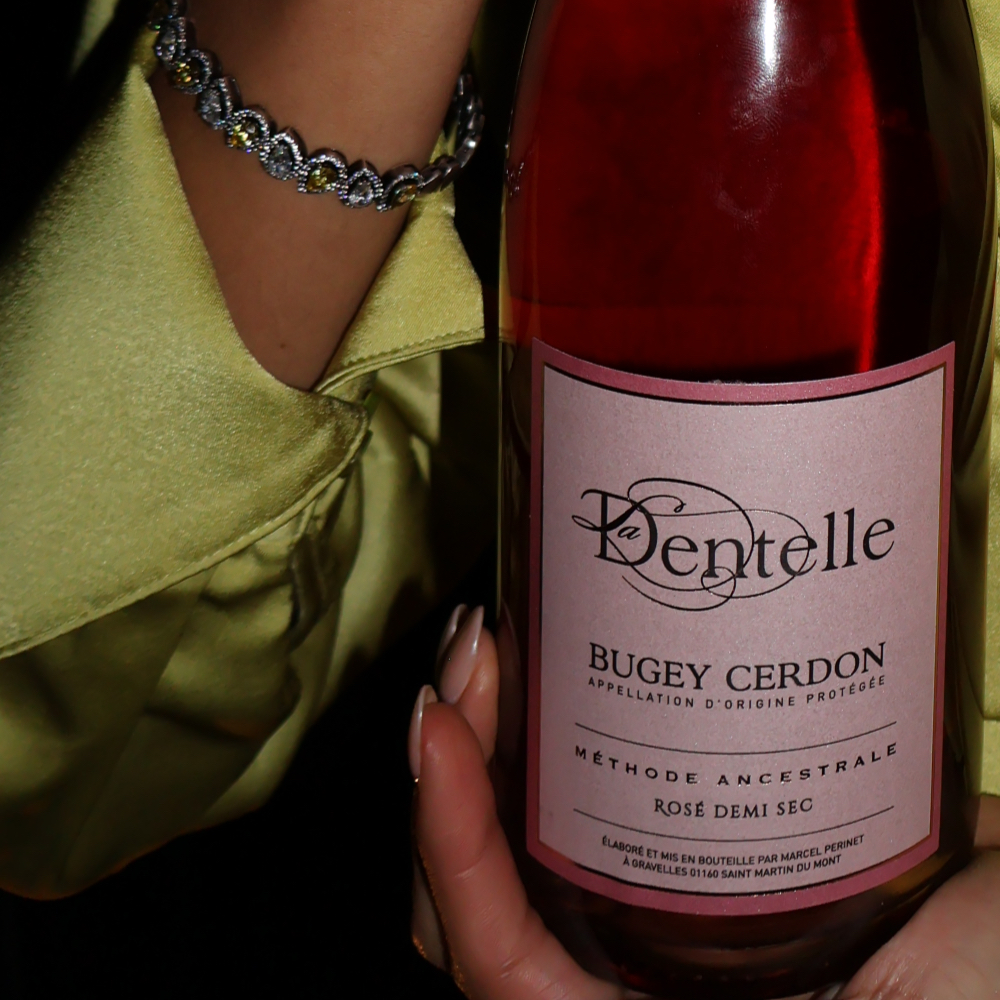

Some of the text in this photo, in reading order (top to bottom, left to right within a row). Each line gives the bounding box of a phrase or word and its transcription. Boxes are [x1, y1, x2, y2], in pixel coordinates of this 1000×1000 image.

[581, 486, 895, 580] Dentelle
[588, 641, 886, 691] BUGEY CERDON
[588, 675, 886, 710] APPELLATION D'ORIGINE PROTÉGÉE
[575, 742, 897, 786] MÉTHODE ANCESTRALE
[653, 798, 813, 819] ROSÉ DEMI SEC
[602, 834, 864, 866] ÉLABORÉ ET MIS EN BOUTEILLE PAR MARCEL PERINET
[623, 854, 841, 879] À GRAVELLES 01160 SAINT MARTIN DU MONT
